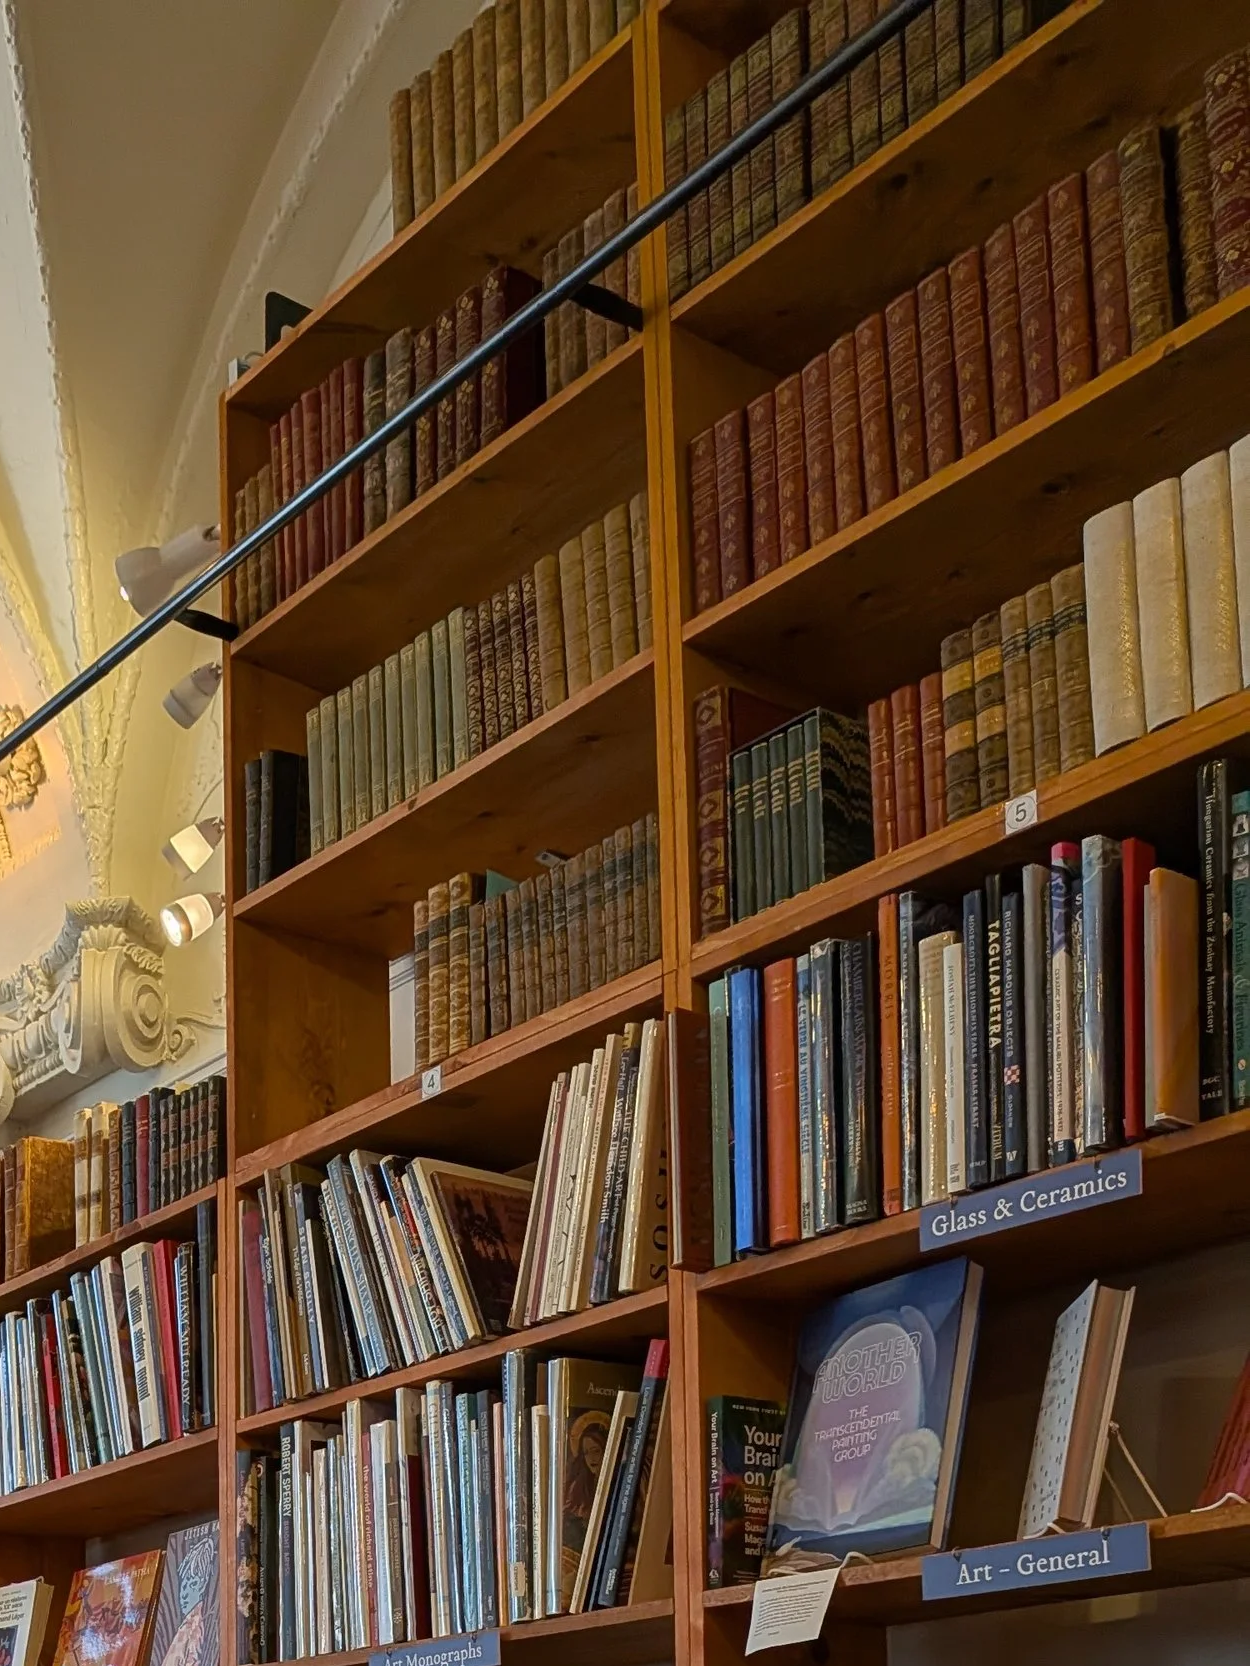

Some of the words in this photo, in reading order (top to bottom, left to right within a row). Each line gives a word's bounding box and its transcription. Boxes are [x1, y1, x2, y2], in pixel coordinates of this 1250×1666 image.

[1014, 802, 1027, 823] 5
[1205, 847, 1213, 890] Ceramics
[1004, 910, 1012, 957] RICHARD
[885, 955, 894, 1019] MORRIS
[988, 919, 1002, 1049] TAGLIAPIETRA
[1005, 959, 1013, 1008] MARQUIS
[1206, 975, 1214, 1034] Manufactory
[1005, 1010, 1014, 1058] OBJECTS
[427, 1075, 435, 1089] 4
[932, 1210, 987, 1237] Glass
[993, 1198, 1014, 1220] &
[1020, 1168, 1128, 1213] Ceramics
[298, 1227, 308, 1264] SEAN
[128, 1285, 143, 1326] william
[133, 1327, 146, 1363] sidney
[813, 1331, 922, 1393] ANOTHER
[137, 1365, 151, 1402] mount
[822, 1361, 906, 1403] WORLD
[814, 1410, 901, 1442] TRANSCENDENTAL
[849, 1405, 869, 1419] THE
[744, 1425, 783, 1446] Your
[832, 1430, 878, 1451] PAINTING
[834, 1444, 871, 1463] GROUP
[280, 1436, 291, 1480] ROBERT
[744, 1446, 779, 1467] Brai
[744, 1472, 765, 1486] on
[282, 1481, 292, 1519] SPERRY
[956, 1563, 993, 1586] Art
[1017, 1540, 1111, 1576] General
